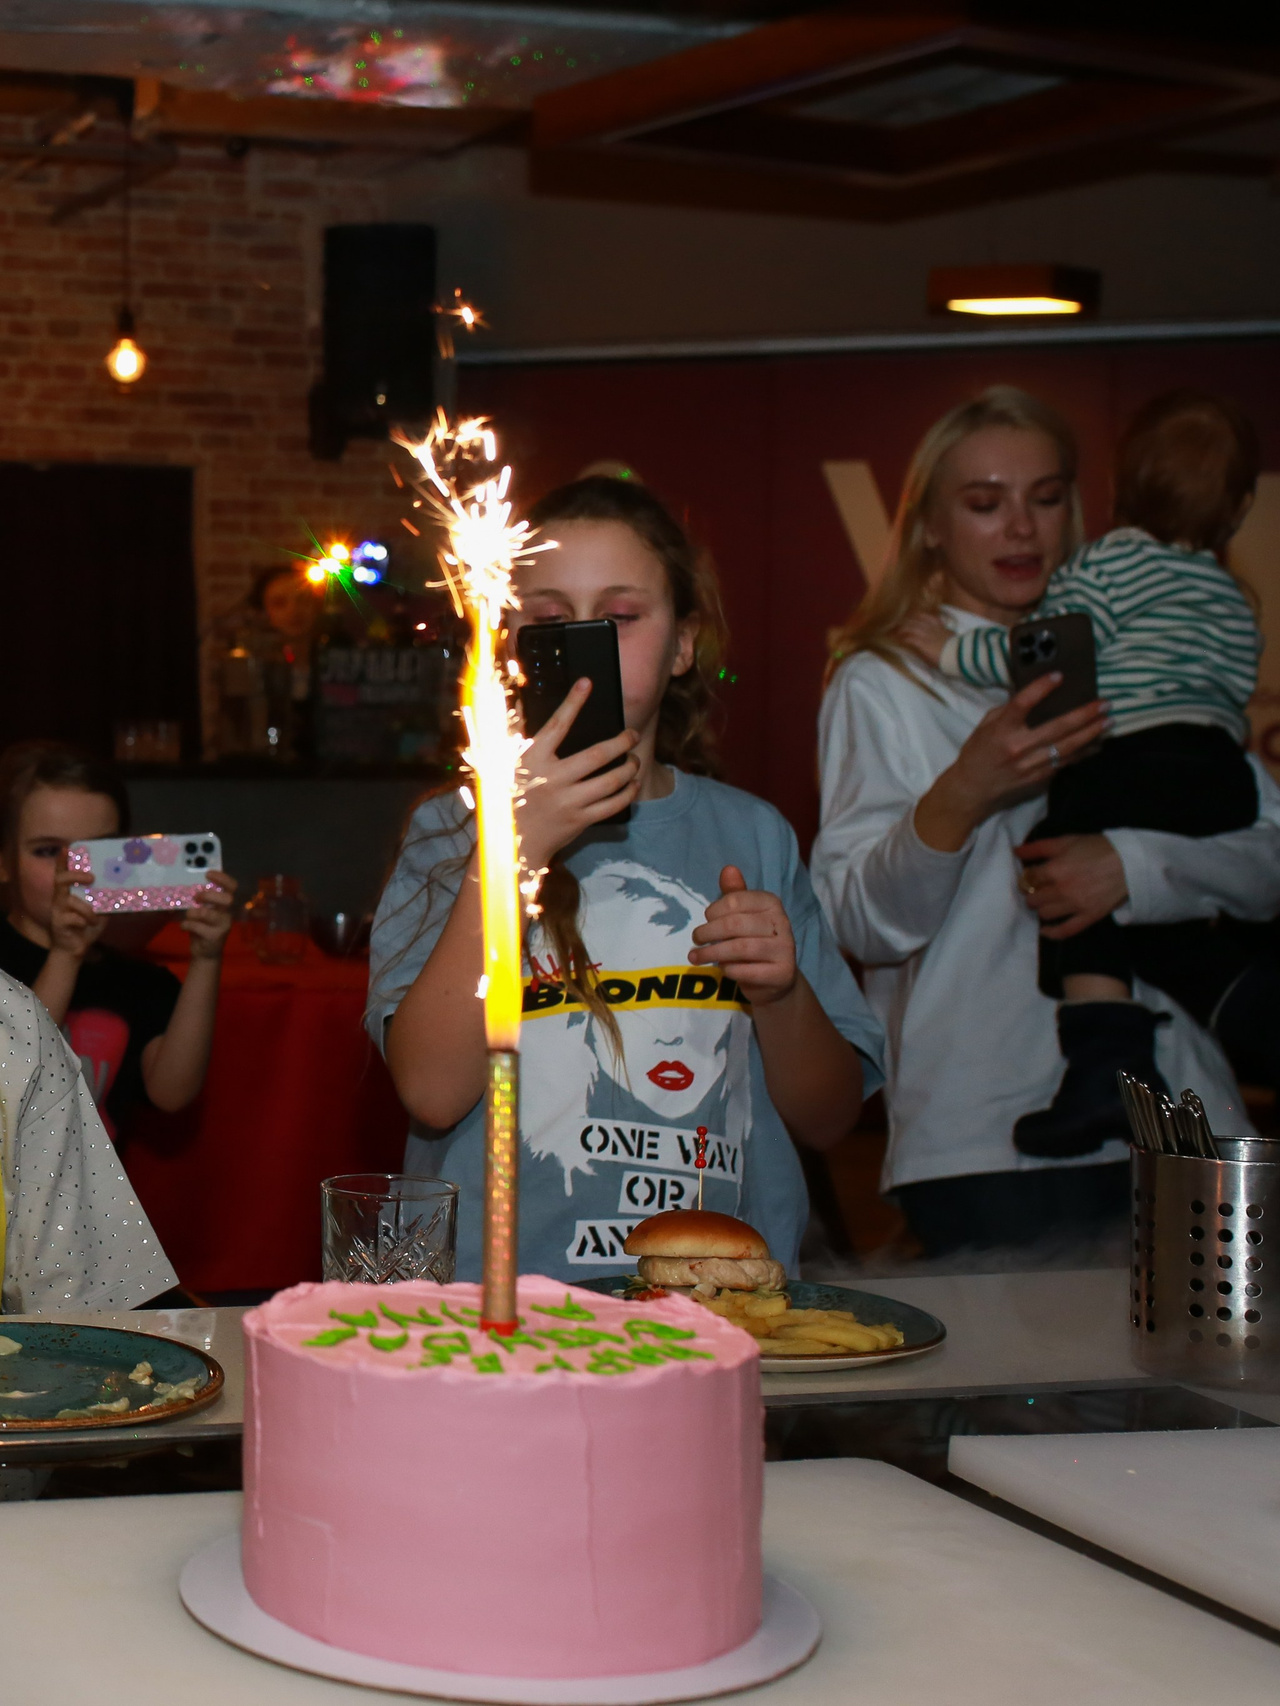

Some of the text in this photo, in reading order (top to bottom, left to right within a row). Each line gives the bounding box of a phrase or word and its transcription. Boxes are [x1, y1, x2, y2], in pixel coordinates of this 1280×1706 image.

[523, 974, 751, 1012] BONDI
[580, 1124, 738, 1173] ONE WAY
[626, 1175, 685, 1210] OR
[576, 1226, 634, 1257] AN
